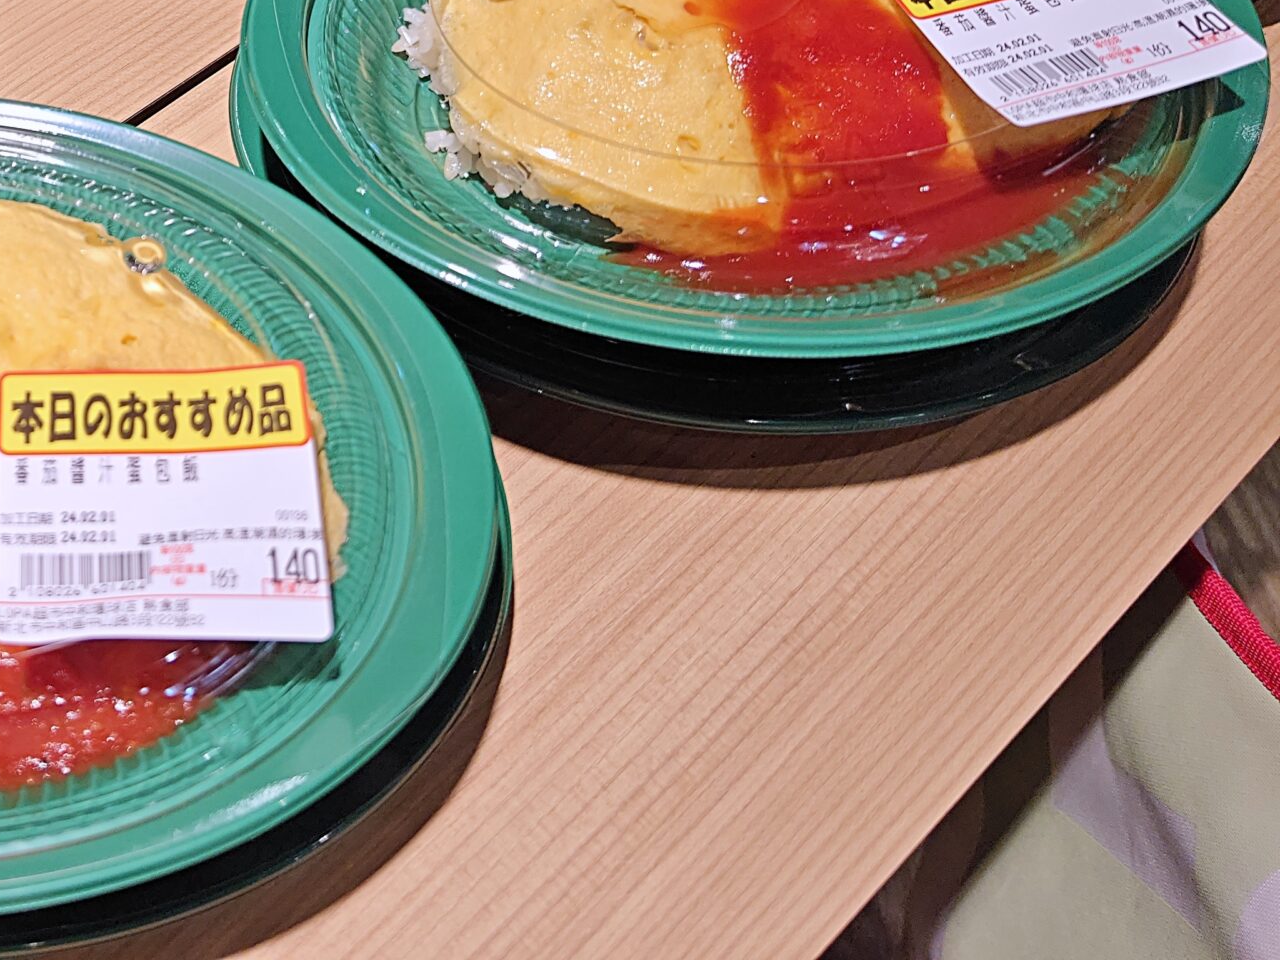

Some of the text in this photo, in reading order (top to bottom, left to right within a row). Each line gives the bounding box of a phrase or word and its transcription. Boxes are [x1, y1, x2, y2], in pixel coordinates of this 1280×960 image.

[1178, 11, 1231, 41] 140
[996, 33, 1042, 53] 24.02.01
[1008, 44, 1054, 63] 24.02.01
[12, 383, 291, 443] 本日のおすすめ品
[268, 547, 319, 584] 140
